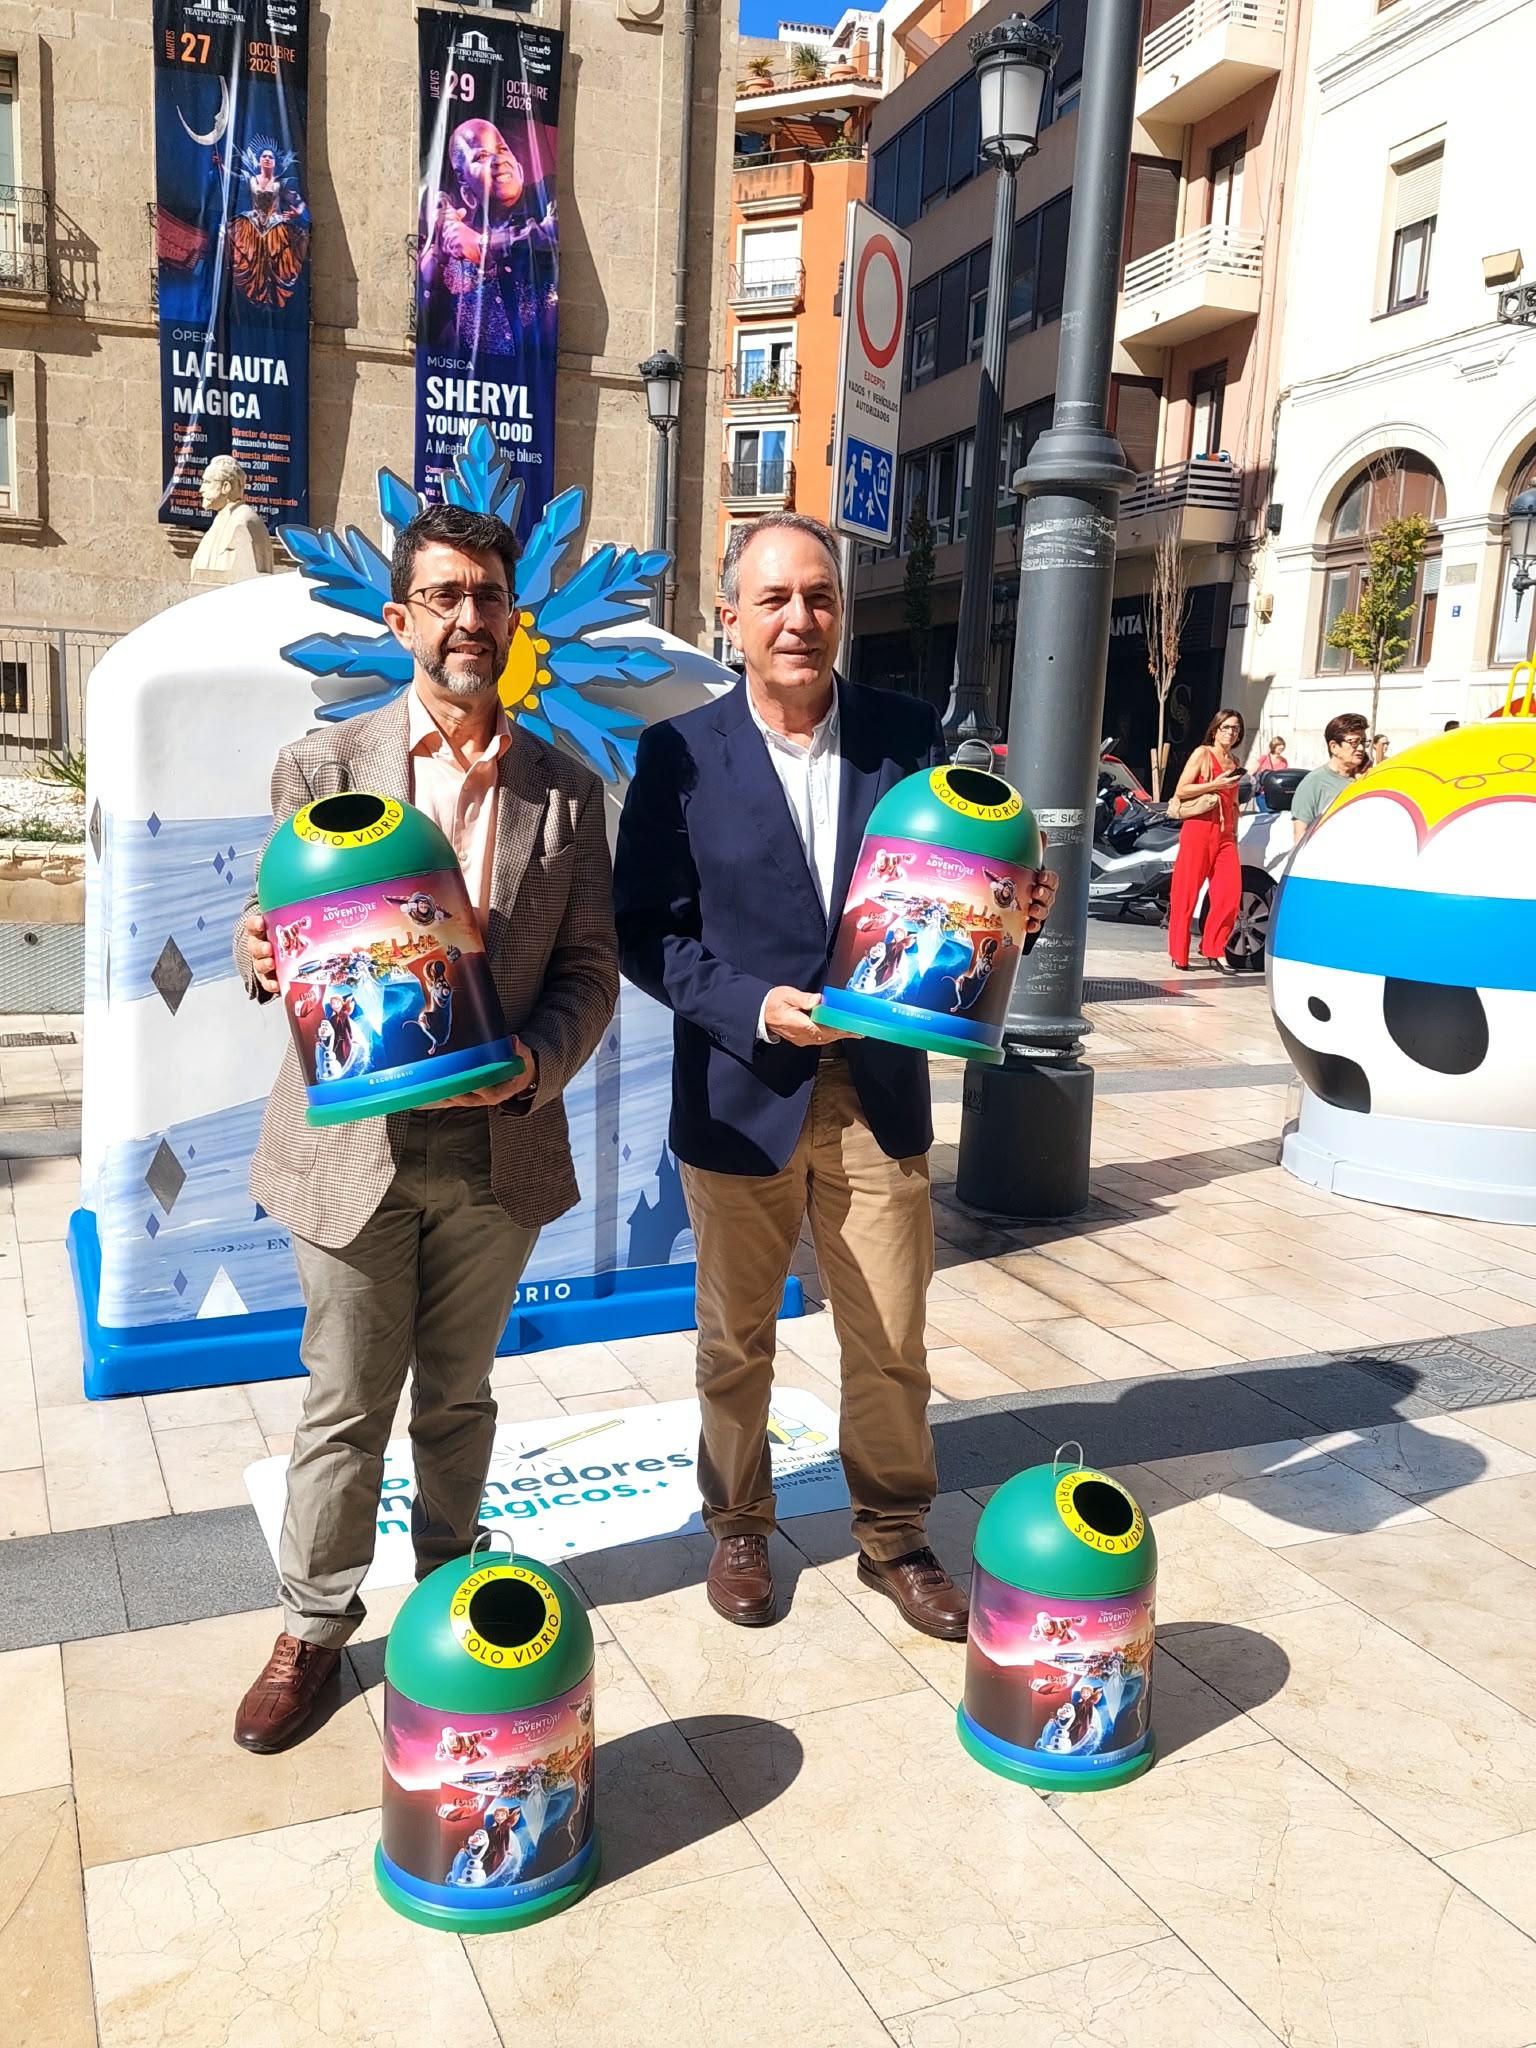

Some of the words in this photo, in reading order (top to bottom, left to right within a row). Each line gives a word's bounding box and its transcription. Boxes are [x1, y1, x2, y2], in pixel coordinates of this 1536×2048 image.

[183, 7, 210, 17] TEATRO
[211, 11, 246, 22] PRINCIPAL
[207, 18, 233, 26] ALICANTE
[165, 30, 175, 60] MARTES
[180, 32, 211, 64] 27
[249, 42, 296, 63] OCTUBRE
[472, 50, 504, 61] PRINCIPAL
[249, 57, 278, 74] 2026
[430, 70, 440, 99] JUEVES
[447, 71, 475, 102] 29
[506, 80, 549, 101] OCTUBRE
[506, 95, 532, 111] 2026
[172, 327, 216, 343] ÓPERA
[172, 349, 201, 378] LA
[205, 351, 289, 386] FLAUTA
[427, 356, 474, 371] MÚSICA
[848, 379, 865, 397] VADOS
[864, 370, 886, 390] EXCEPTO
[173, 381, 261, 420] MÁGICA
[426, 376, 534, 419] SHERYL
[856, 399, 890, 423] AUTORIZADOS
[232, 427, 258, 439] Director
[232, 449, 260, 461] Orquesta
[425, 439, 433, 453] A
[500, 446, 516, 462] the
[516, 447, 543, 464] blues
[252, 461, 269, 470] 2001
[252, 482, 270, 491] 2001
[935, 783, 968, 811] SOLO
[976, 799, 1020, 818] VIDRIO
[301, 826, 344, 846] SOLO
[353, 809, 401, 843] VIDRIO
[926, 858, 975, 876] ADVENTURE
[323, 901, 377, 922] ADVENTURE
[785, 1465, 840, 1479] nuevos
[478, 1483, 652, 1519] ágicos.
[1058, 1474, 1082, 1514] VIDRIO
[1074, 1523, 1116, 1551] SOLO
[1121, 1507, 1144, 1549] VIDRIO
[453, 1569, 497, 1616] VIDRIO
[514, 1569, 555, 1600] SOLO
[461, 1629, 504, 1664] SOLO
[513, 1614, 559, 1663] VIDRIO
[511, 1711, 561, 1735] ADVENTURE
